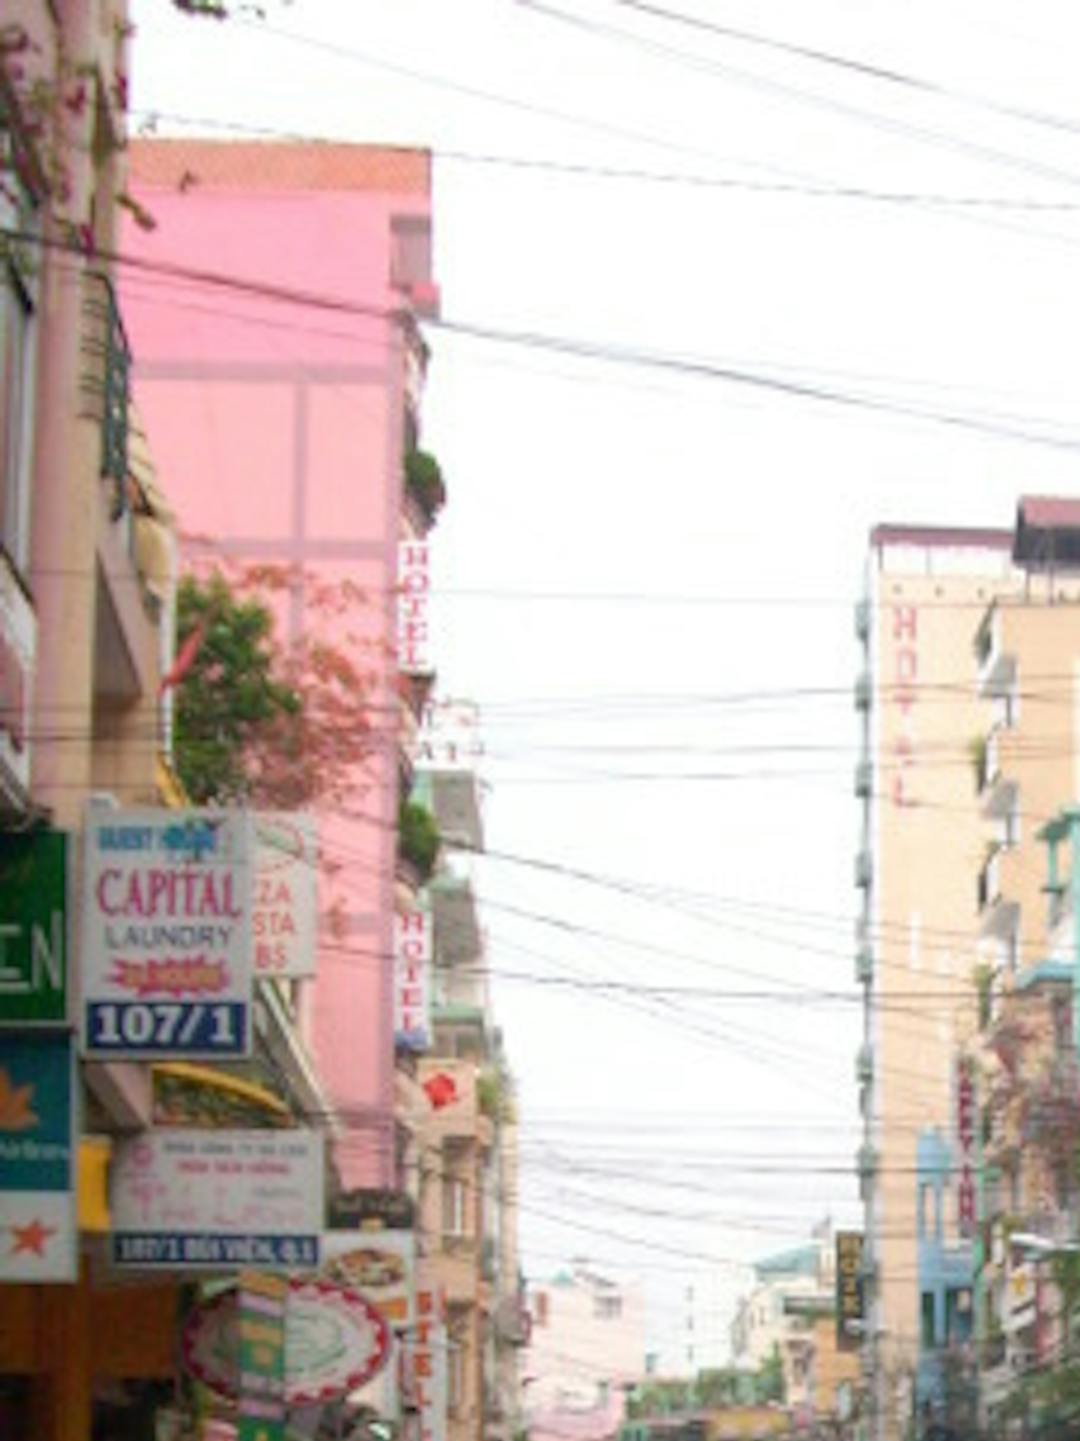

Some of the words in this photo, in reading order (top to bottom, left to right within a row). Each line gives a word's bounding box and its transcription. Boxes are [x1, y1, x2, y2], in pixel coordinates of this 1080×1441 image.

[406, 546, 428, 666] HOTEL
[893, 607, 917, 808] HOTEL
[96, 861, 242, 918] CAPITAL
[105, 924, 234, 949] LAUNDRY
[402, 912, 424, 1032] HOTEL
[95, 1004, 236, 1043] 107/1
